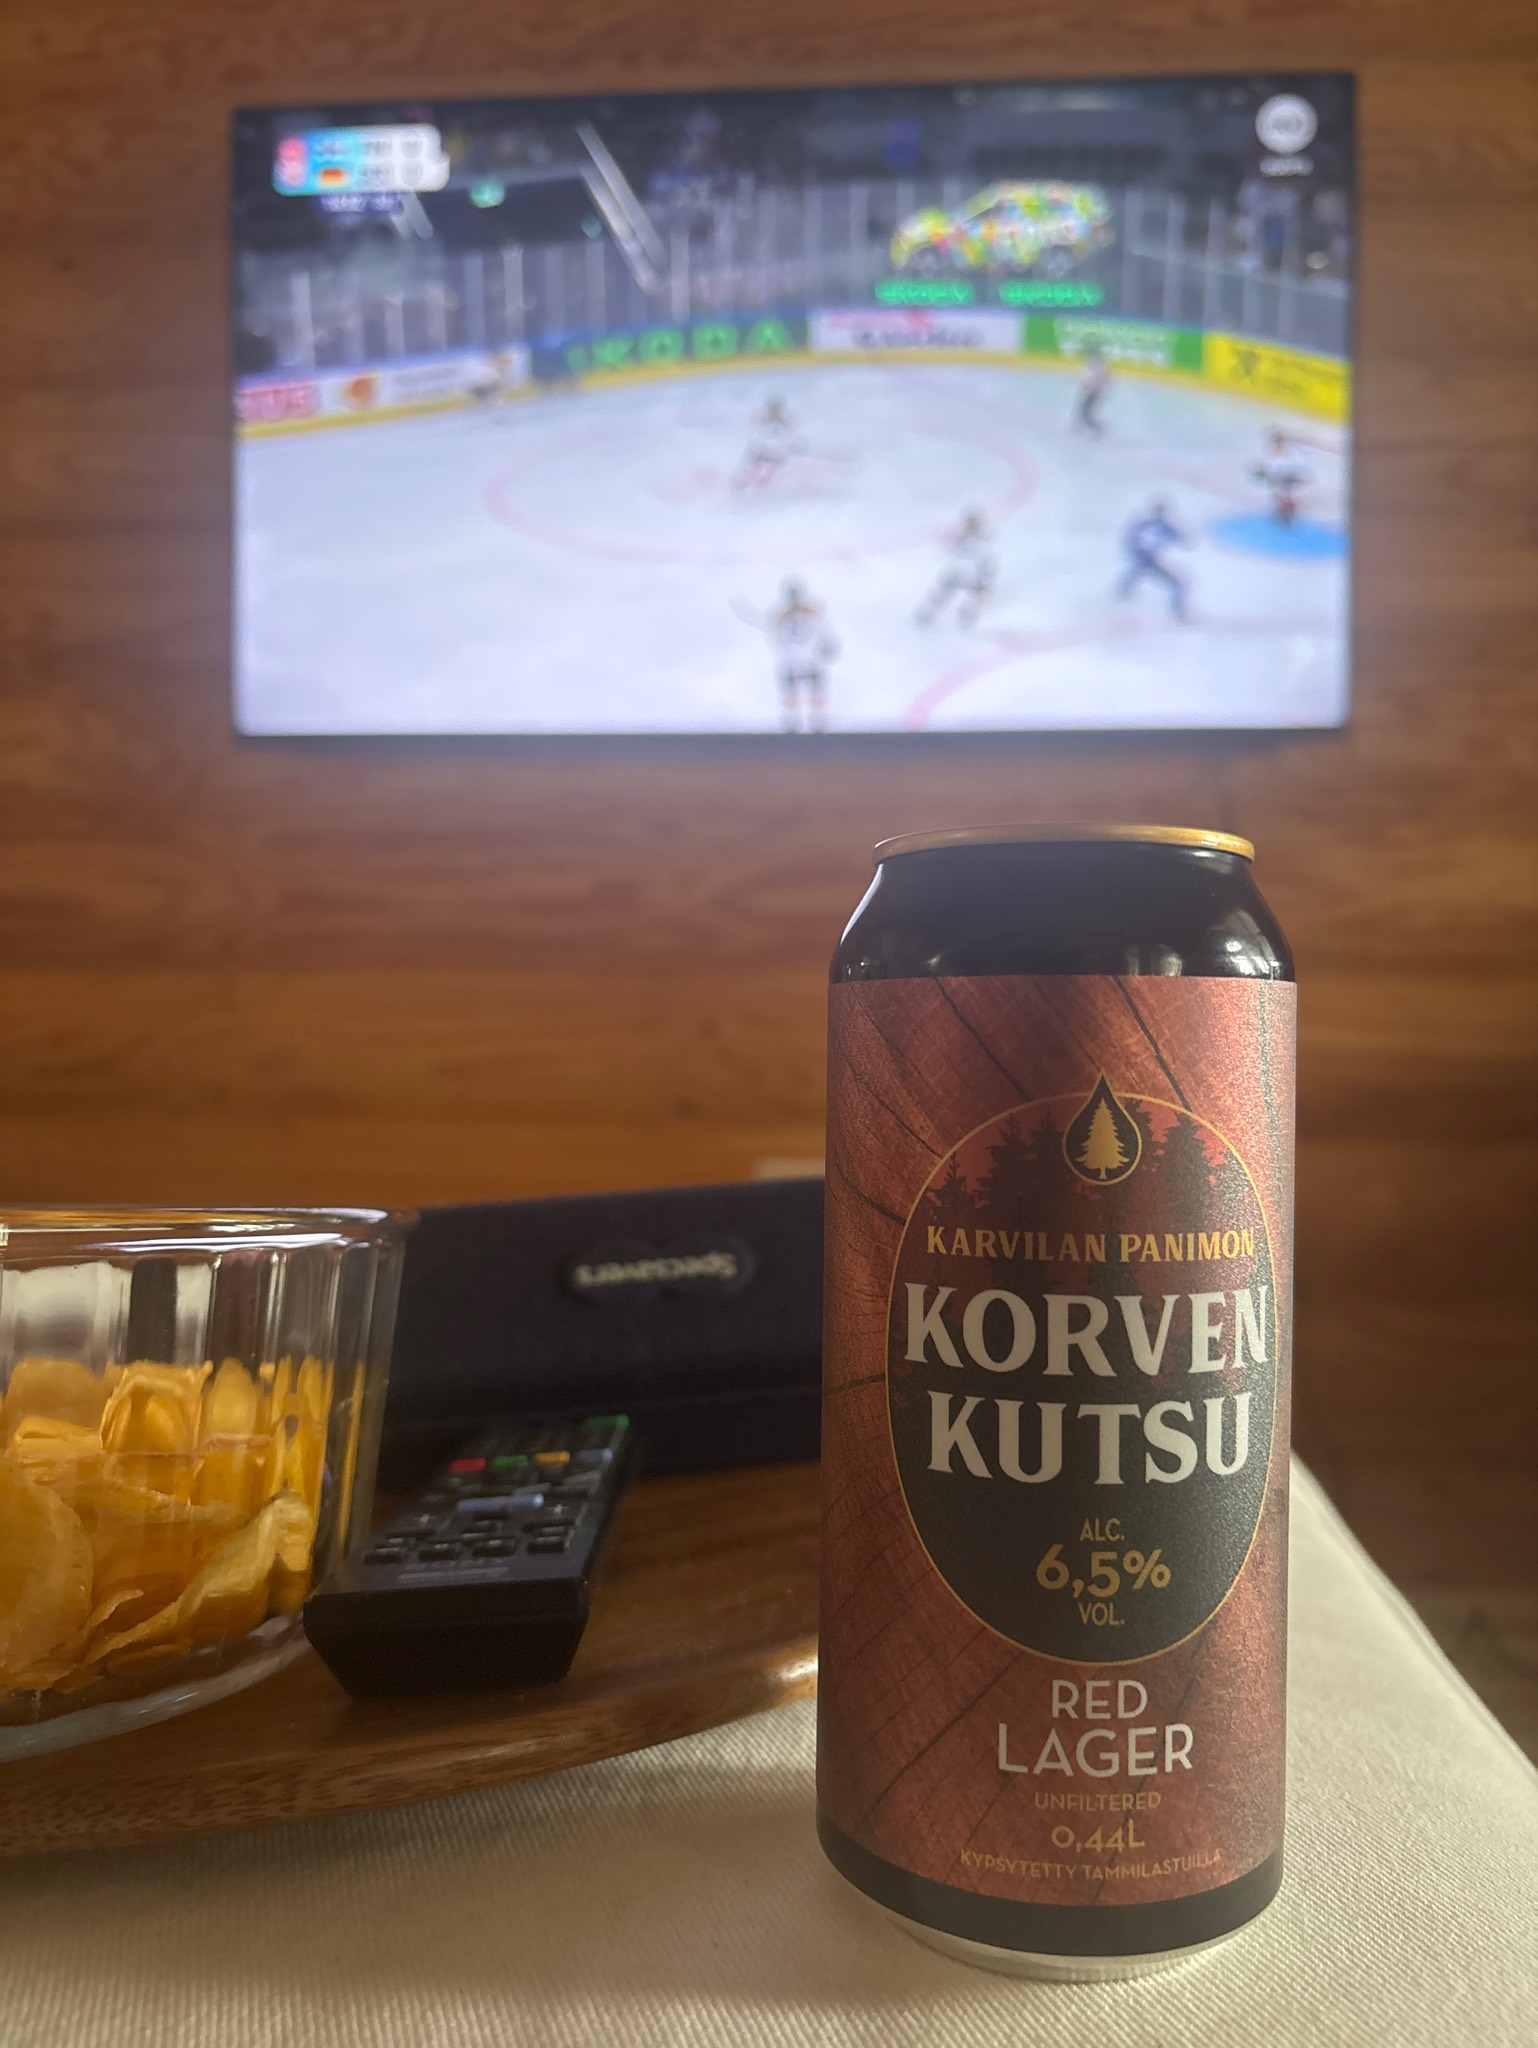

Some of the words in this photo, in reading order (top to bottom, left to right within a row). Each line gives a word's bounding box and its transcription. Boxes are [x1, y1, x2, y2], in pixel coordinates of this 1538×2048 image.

[926, 1225, 1106, 1263] KARVILAN
[1119, 1227, 1255, 1263] PANIMON
[904, 1282, 1270, 1377] KORVEN
[926, 1390, 1253, 1485] KUTSU
[1079, 1517, 1126, 1542] ALC.
[1035, 1543, 1172, 1599] 6,5%
[1077, 1602, 1126, 1627] VOL.
[1050, 1679, 1149, 1720] RED
[997, 1722, 1195, 1778] LAGER
[1034, 1791, 1162, 1813] UNFILTERED
[1050, 1817, 1146, 1854] 0,44L
[960, 1848, 1077, 1880] KYPSYTETTY
[1083, 1848, 1223, 1881] TAMMILASTUILLA
